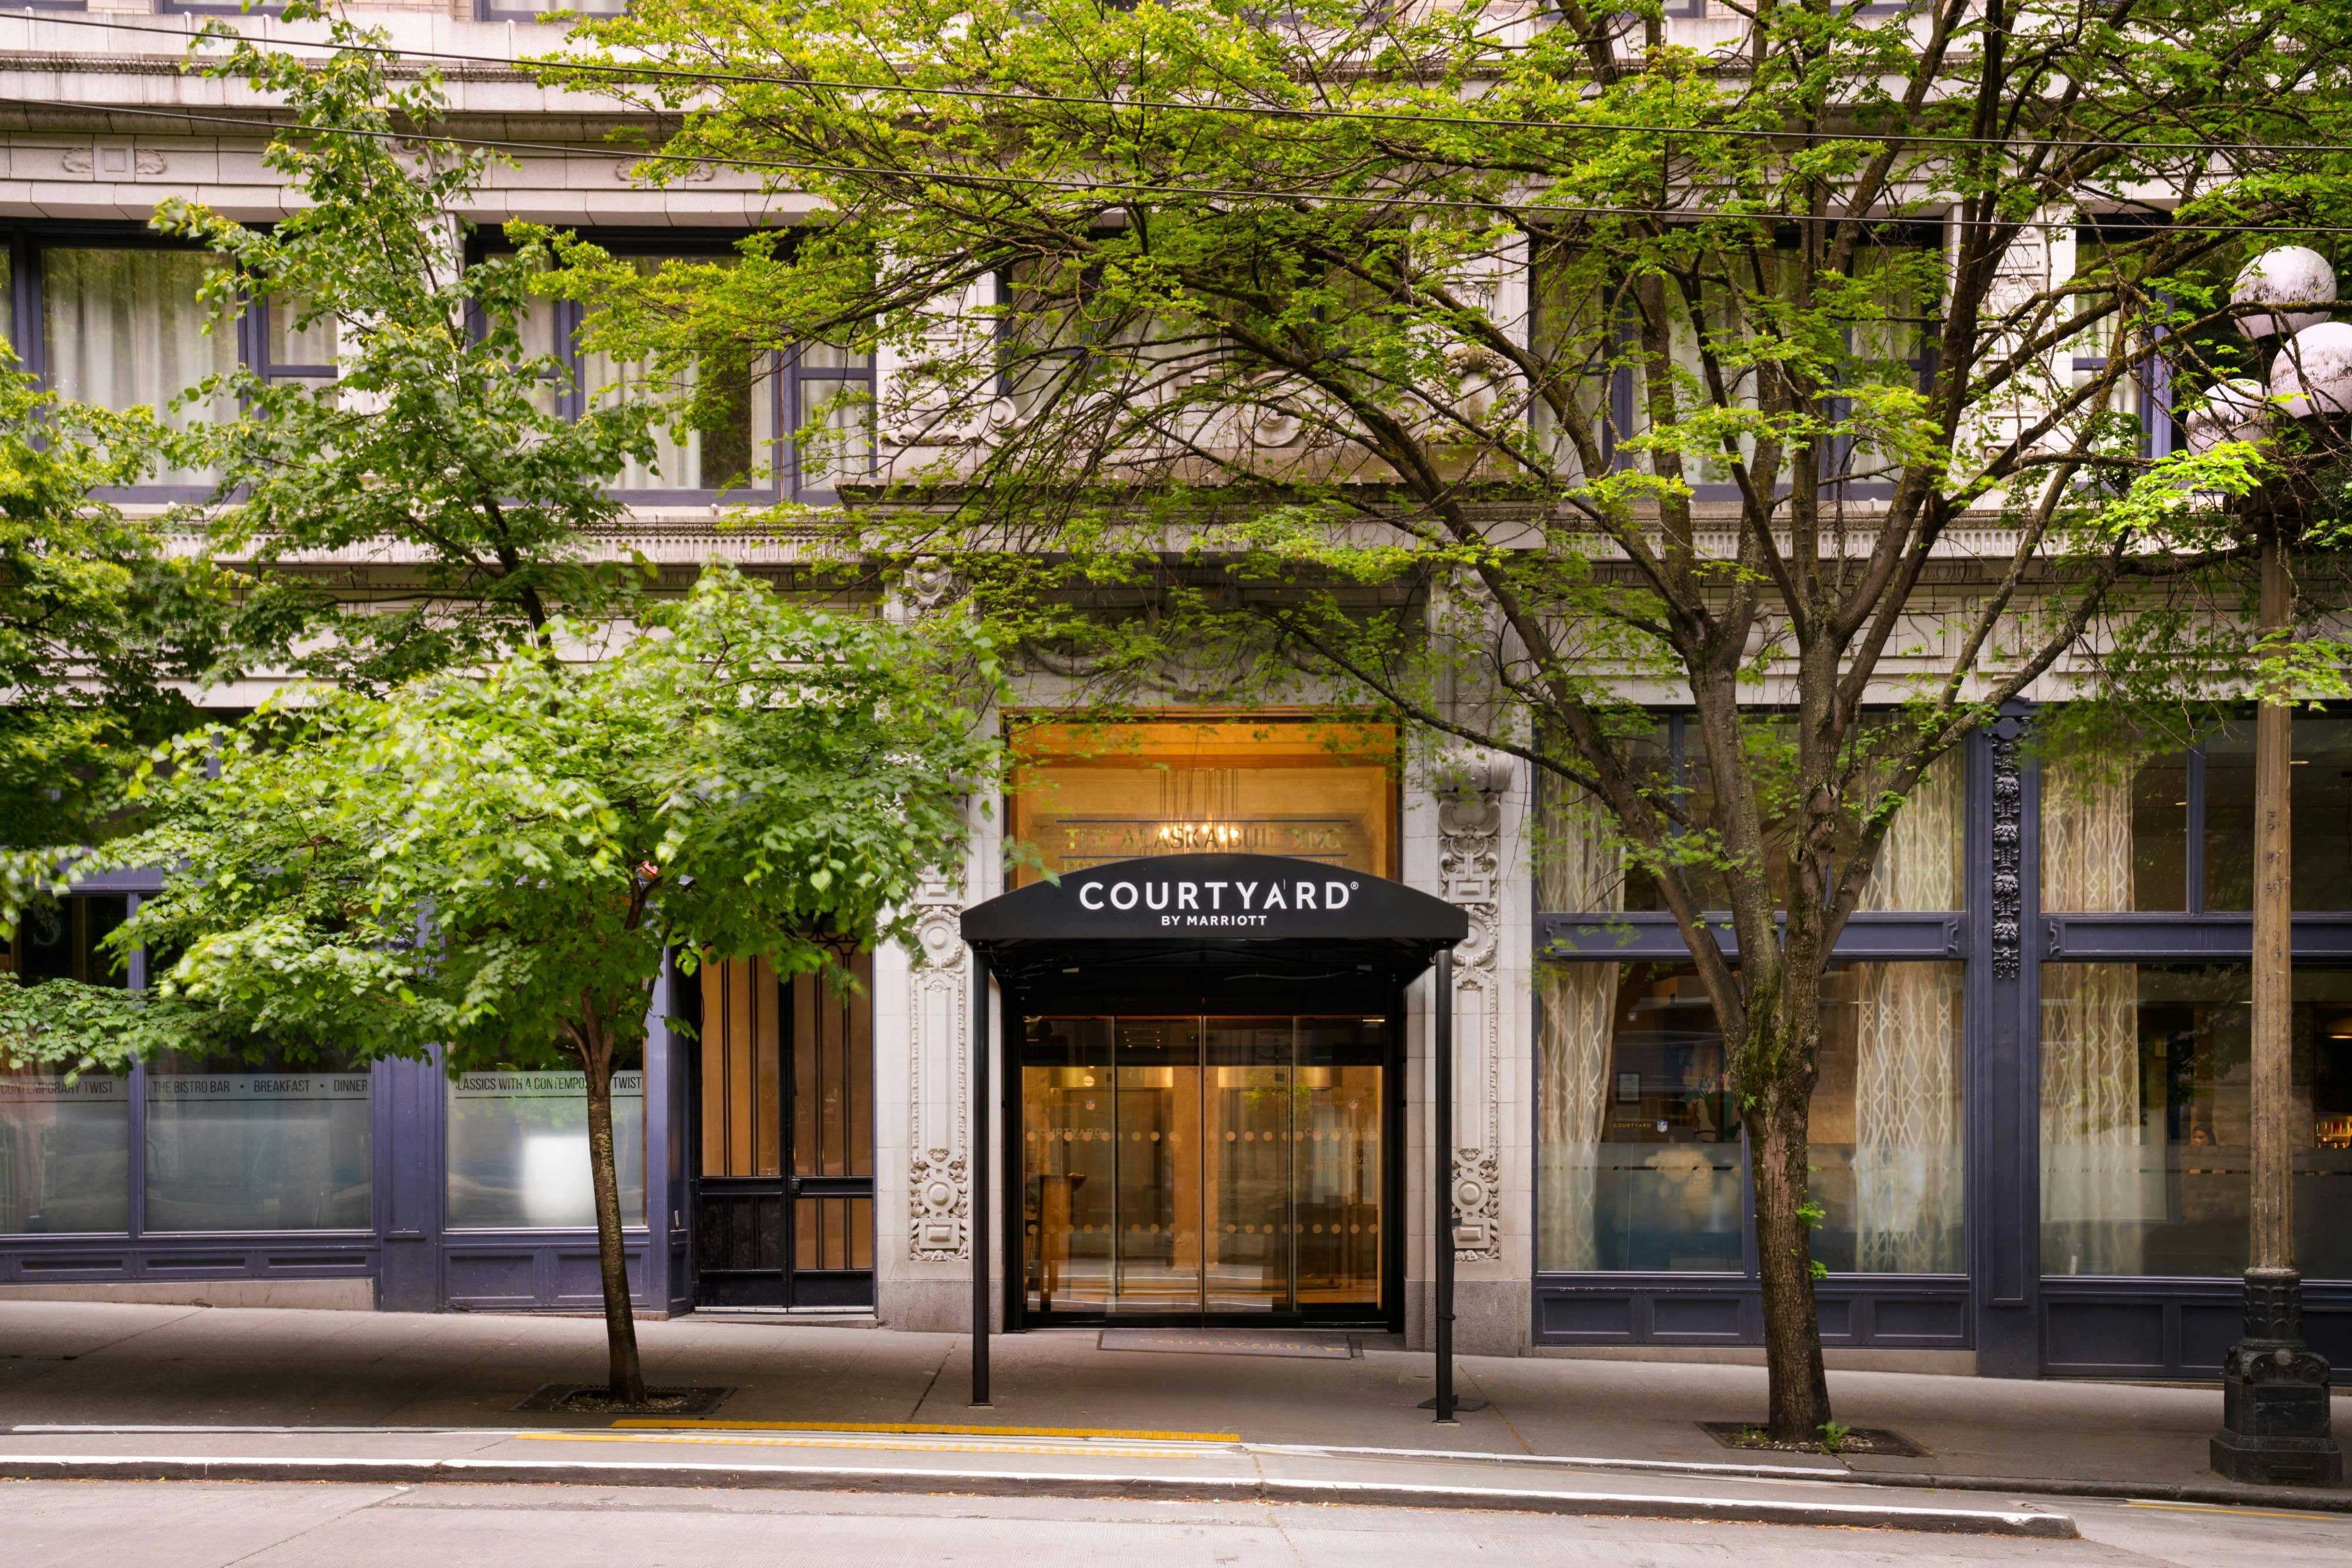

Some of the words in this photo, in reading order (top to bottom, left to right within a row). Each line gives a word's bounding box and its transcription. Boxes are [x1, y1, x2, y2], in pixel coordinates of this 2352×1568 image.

[1065, 828, 1110, 849] THE
[1121, 828, 1219, 849] ALASKA
[1228, 828, 1341, 849] BUILDING
[1161, 915, 1180, 926] BY
[1187, 915, 1267, 926] MARRIOTT
[83, 1081, 113, 1094] TWIST
[152, 1081, 171, 1094] THE
[173, 1081, 208, 1094] BISTRO
[210, 1080, 230, 1093] BAR
[254, 1079, 310, 1093] BREAKFAST
[333, 1079, 368, 1092] DINNER
[455, 1078, 496, 1091] LASSICS
[499, 1078, 522, 1090] WITH
[525, 1077, 532, 1089] A
[613, 1076, 642, 1089] TWIST
[1140, 1339, 1300, 1349] COURTYARD
